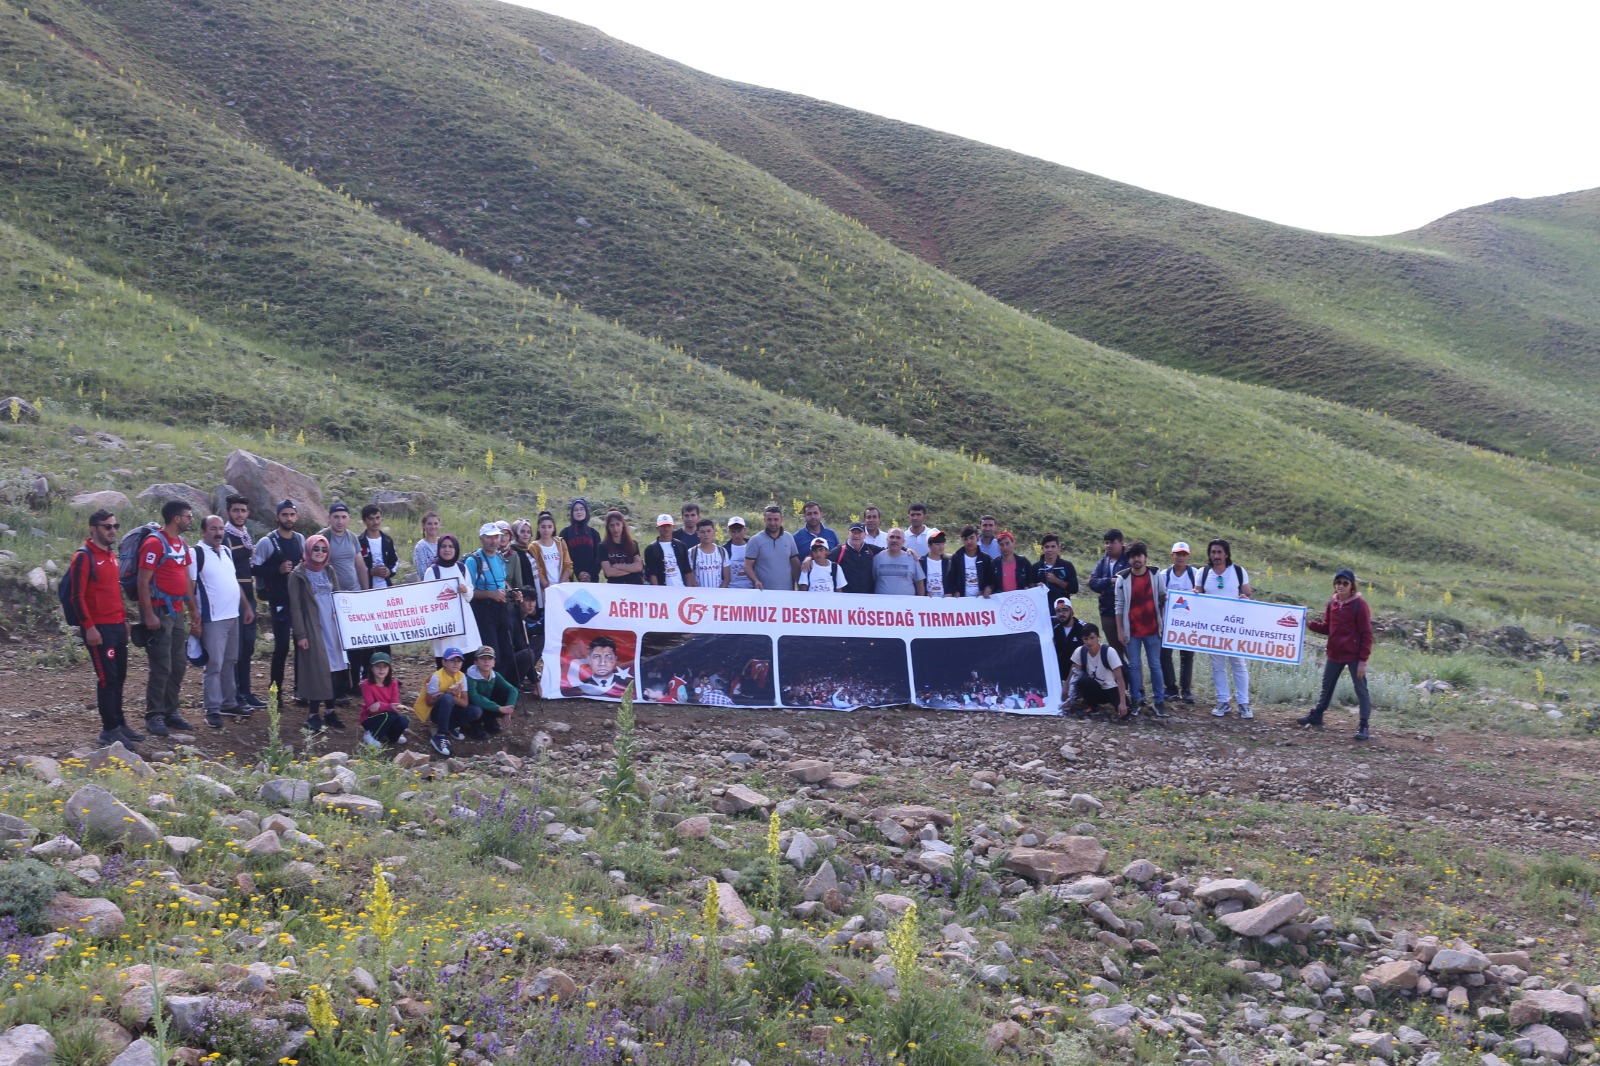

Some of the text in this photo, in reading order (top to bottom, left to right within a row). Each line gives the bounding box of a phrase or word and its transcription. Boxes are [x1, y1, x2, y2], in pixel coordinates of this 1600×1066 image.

[348, 602, 449, 623] GENÇLİK HİZMETLERİ VE SPOR
[386, 597, 404, 607] AĞRI
[608, 598, 669, 620] AĞRI'DA
[712, 604, 777, 623] TEMMUZ
[781, 607, 843, 625] DESTANI
[847, 607, 915, 627] KÖSEDAĞ
[918, 610, 996, 628] TIRMANIŞI
[374, 616, 426, 631] İL MÜDÜRLÜĞÜ
[1171, 618, 1295, 642] İBRAHİM ÇEÇEN ÜNİVERSİTESİ
[1223, 614, 1245, 625] AĞRI
[350, 621, 456, 646] DAĞCILIK İL TEMSİLCİLİĞİ
[1166, 630, 1297, 659] DAĞCILIK KULÜBÜ
